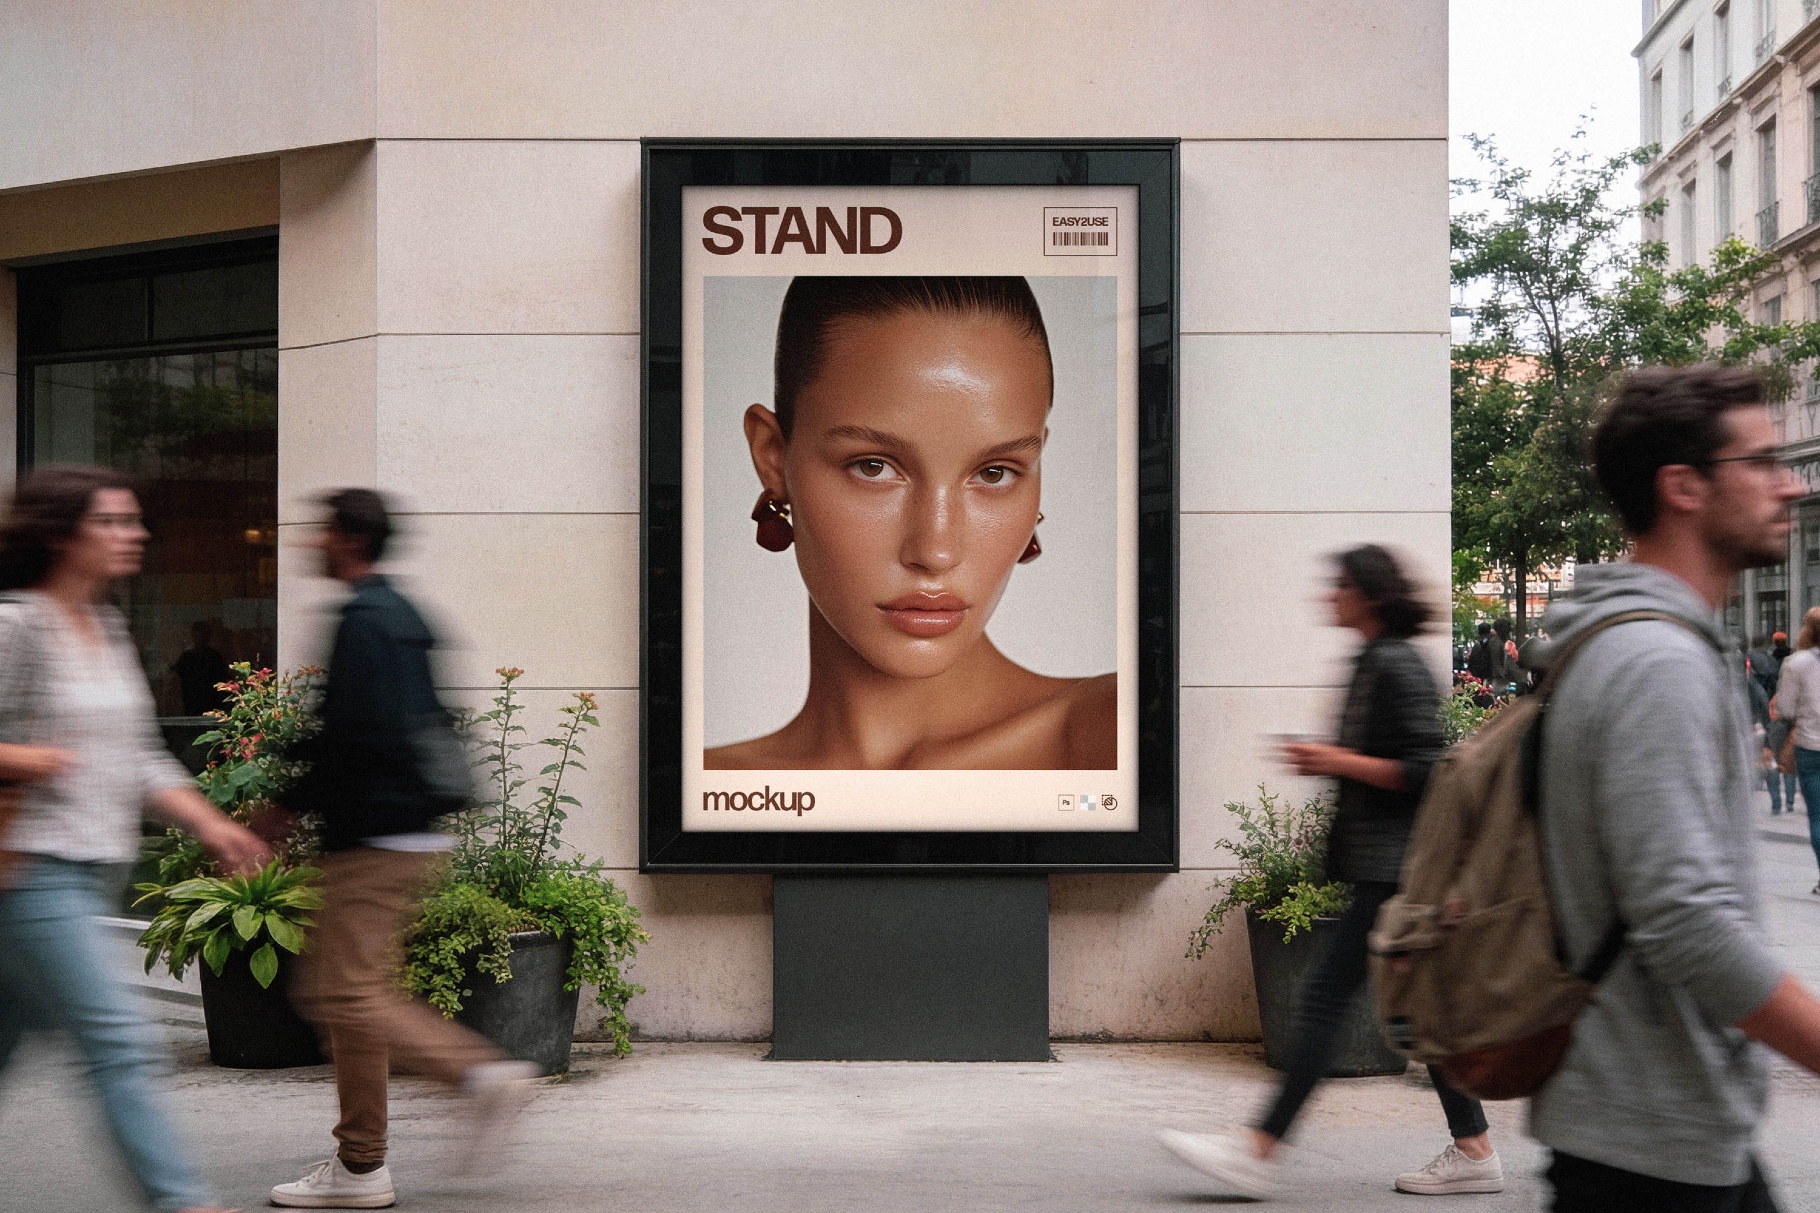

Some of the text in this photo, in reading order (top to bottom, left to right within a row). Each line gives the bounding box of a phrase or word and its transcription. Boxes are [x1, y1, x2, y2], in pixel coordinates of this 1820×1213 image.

[702, 205, 903, 255] STAND
[1052, 216, 1109, 227] EASY2USE
[702, 785, 816, 817] mockup
